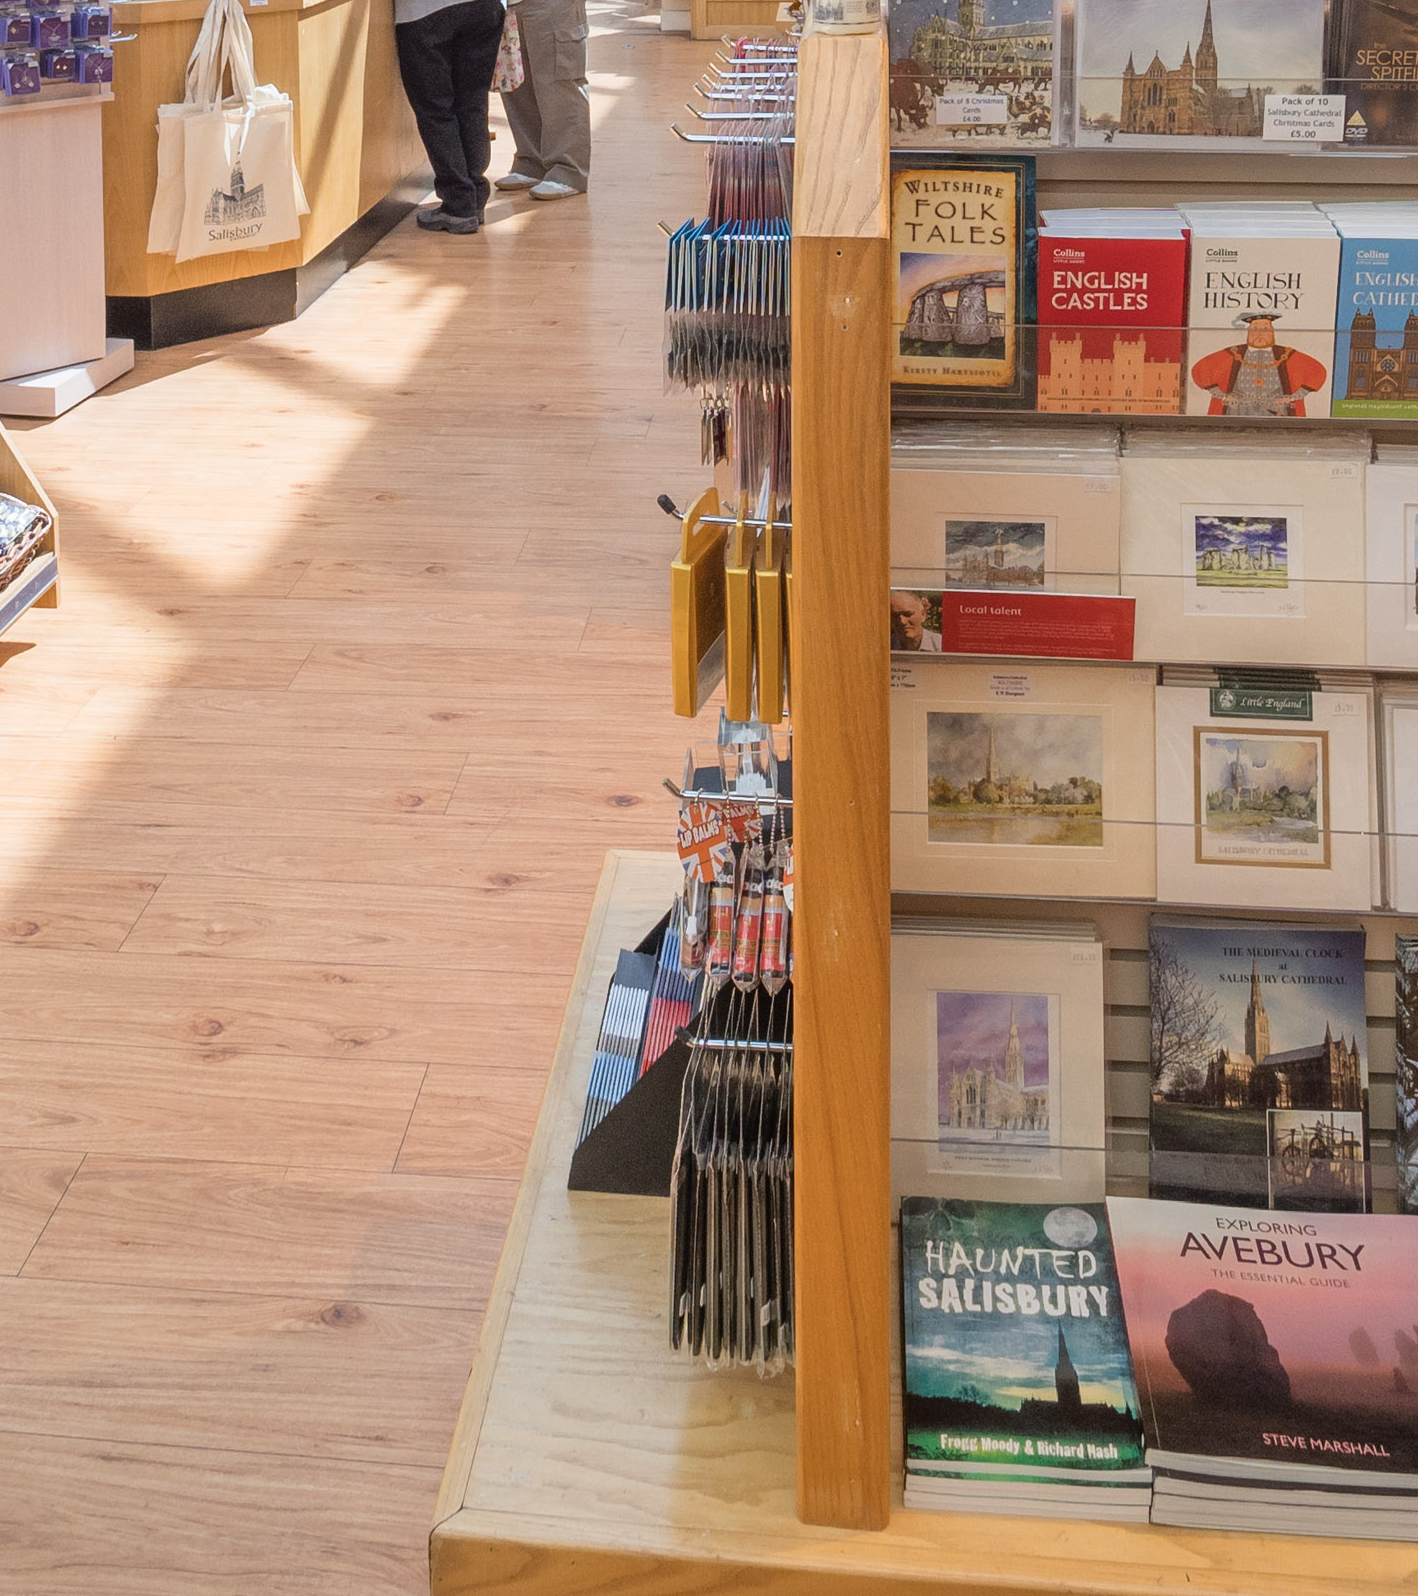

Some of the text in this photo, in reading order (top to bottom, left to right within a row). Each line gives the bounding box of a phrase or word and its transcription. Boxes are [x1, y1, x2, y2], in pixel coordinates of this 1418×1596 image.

[1267, 108, 1341, 117] Salisbury Cathedral
[915, 199, 998, 221] FOLK
[208, 223, 262, 241] Salisbury
[904, 222, 1006, 245] TALES
[1053, 271, 1148, 290] ENGLISH
[1204, 272, 1301, 290] ENGLISH
[1052, 293, 1148, 310] CASTLES
[1203, 292, 1304, 309] HISTORY
[959, 605, 1021, 616] Local talent
[680, 819, 723, 848] LIP BALMS
[1215, 1218, 1317, 1236] EXPLORING
[925, 1240, 1097, 1279] HAUNTED
[1180, 1232, 1365, 1271] AVEBURY
[1212, 1268, 1350, 1288] THE ESSENTIAL GUIDE
[918, 1277, 1109, 1318] SALISBURY
[940, 1433, 1118, 1459] Frogg Moody & Richard Nash
[1262, 1433, 1390, 1457] STEVE MARSHALL
